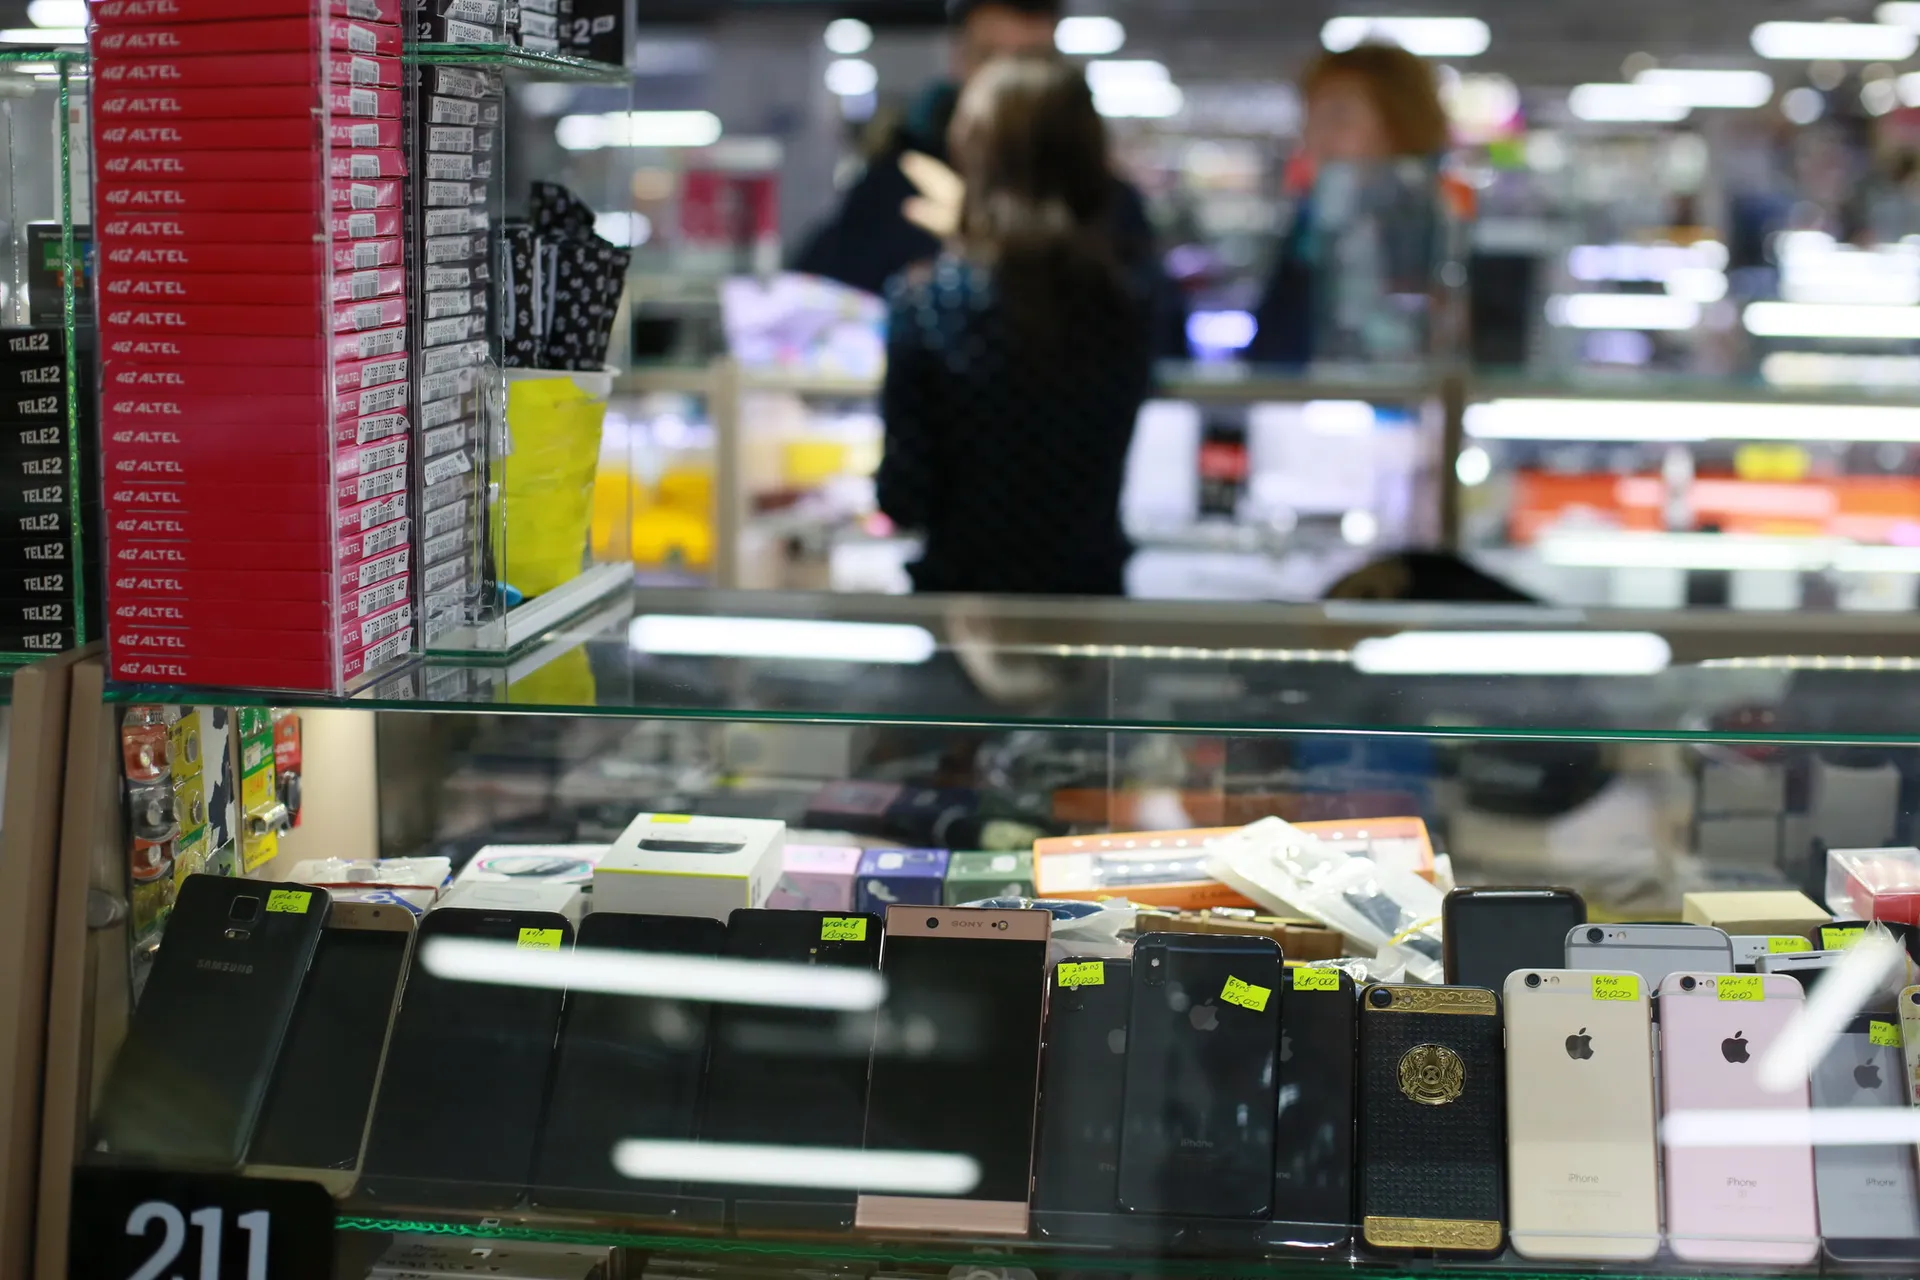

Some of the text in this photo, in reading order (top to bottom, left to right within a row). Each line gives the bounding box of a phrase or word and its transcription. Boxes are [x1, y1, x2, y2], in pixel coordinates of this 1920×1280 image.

[125, 0, 180, 14] ALTEL
[126, 33, 179, 46] ALTEL
[127, 65, 180, 78] ALTEL
[128, 98, 181, 111] ALTEL
[128, 128, 181, 141] ALTEL
[130, 159, 183, 171] ALTEL
[131, 191, 185, 203] ALTEL
[130, 222, 184, 235] ALTEL
[134, 250, 188, 262] ALTEL
[133, 281, 186, 294] ALTEL
[133, 312, 186, 325] ALTEL
[397, 330, 403, 340] 4G
[8, 332, 49, 351] TELE2
[134, 343, 179, 353] ALTEL
[399, 361, 405, 371] 4G
[20, 365, 60, 383] TELE2
[138, 373, 184, 384] ALTEL
[398, 385, 404, 395] 4G
[17, 396, 58, 414] TELE2
[135, 403, 181, 413] ALTEL
[396, 416, 403, 426] 4G
[19, 427, 60, 444] TELE2
[134, 432, 180, 443] ALTEL
[398, 443, 404, 453] 4G
[22, 457, 62, 474] TELE2
[138, 461, 183, 472] ALTEL
[396, 468, 402, 478] 4G
[22, 485, 62, 503] TELE2
[135, 492, 180, 502] ALTEL
[398, 496, 404, 507] 4G
[19, 513, 59, 530] TELE2
[138, 521, 183, 531] ALTEL
[400, 521, 406, 531] 4G
[24, 542, 64, 560] TELE2
[139, 550, 185, 560] ALTEL
[398, 552, 405, 562] 4G
[24, 574, 63, 591] TELE2
[137, 579, 182, 590] ALTEL
[398, 580, 405, 590] 4G
[22, 604, 62, 621] TELE2
[138, 607, 183, 618] ALTEL
[401, 607, 408, 617] 4G
[23, 632, 62, 649] TELE2
[140, 636, 184, 647] ALTEL
[401, 631, 408, 641] 4G
[140, 665, 186, 675] ALTEL
[951, 920, 984, 928] SONY
[196, 959, 254, 975] SAMSUNG
[1180, 1138, 1214, 1148] iPhone
[1568, 1173, 1599, 1184] iPhone
[1726, 1177, 1757, 1188] iPhone
[1866, 1178, 1896, 1188] iPhone
[125, 1200, 270, 1280] 211
